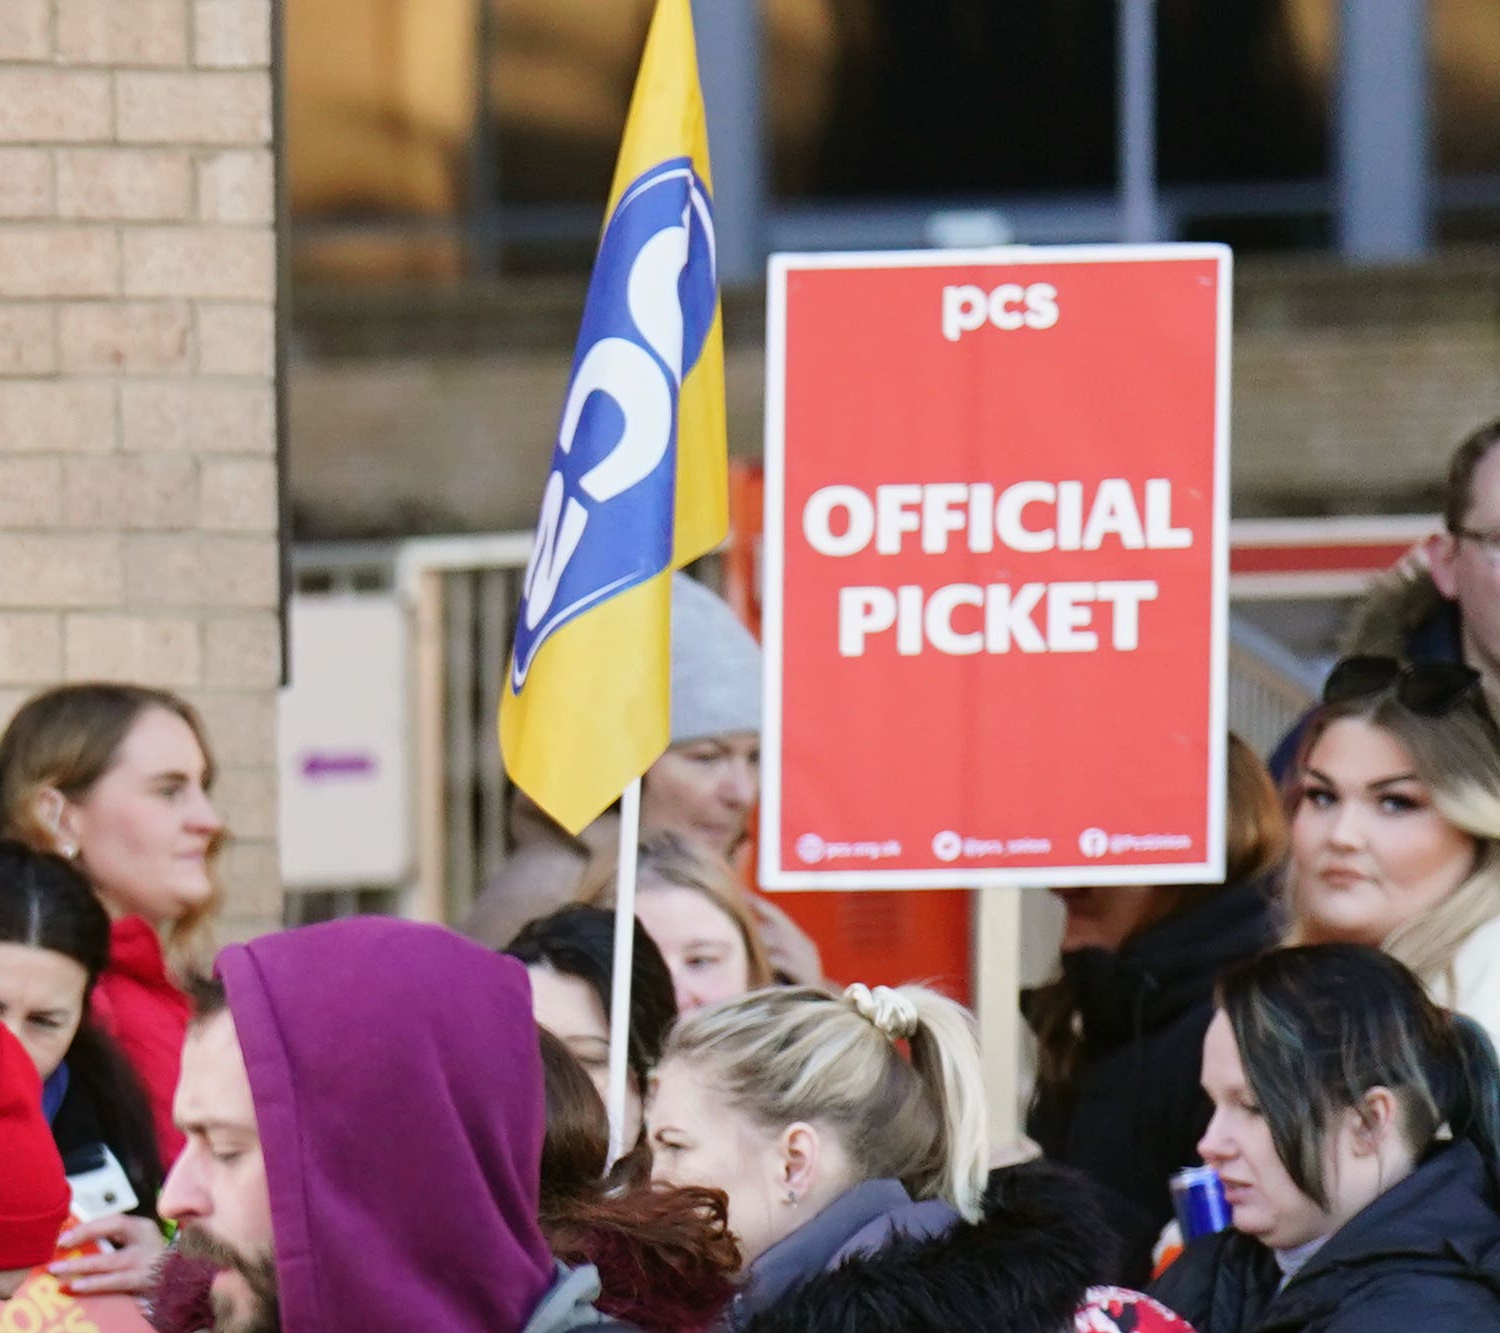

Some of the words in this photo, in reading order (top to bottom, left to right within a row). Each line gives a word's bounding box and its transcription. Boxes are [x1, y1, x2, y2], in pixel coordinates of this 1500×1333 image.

[942, 283, 1059, 341] pcs
[802, 478, 1193, 557] OFFICIAL
[838, 580, 1158, 657] PICKET
